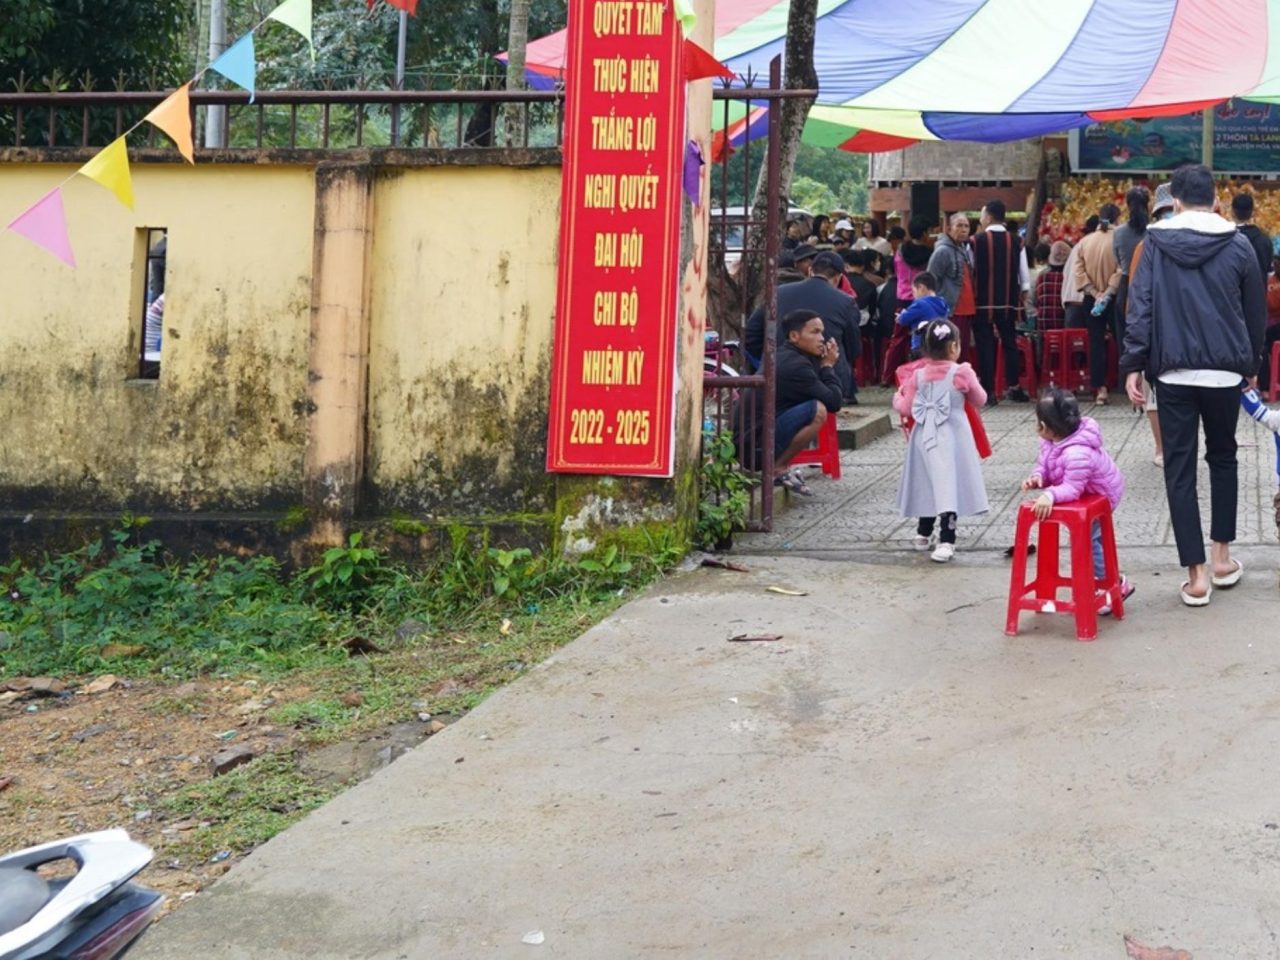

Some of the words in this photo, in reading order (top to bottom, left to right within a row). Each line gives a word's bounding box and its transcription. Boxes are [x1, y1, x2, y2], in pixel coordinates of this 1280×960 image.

[593, 54, 627, 99] THỰC
[630, 54, 659, 100] HIỆN
[592, 106, 633, 150] THẮNG
[636, 112, 657, 158] LỢI
[584, 174, 616, 216] NGHỊ
[619, 164, 659, 212] QUYẾT
[594, 233, 617, 274] ĐẠI
[620, 227, 643, 274] HỘI
[594, 291, 617, 326] CHI
[620, 286, 639, 333] BỘ
[582, 344, 623, 391] NHIỆM
[626, 345, 644, 385] KỲ
[570, 409, 604, 445] 2022
[615, 410, 650, 445] 2025
